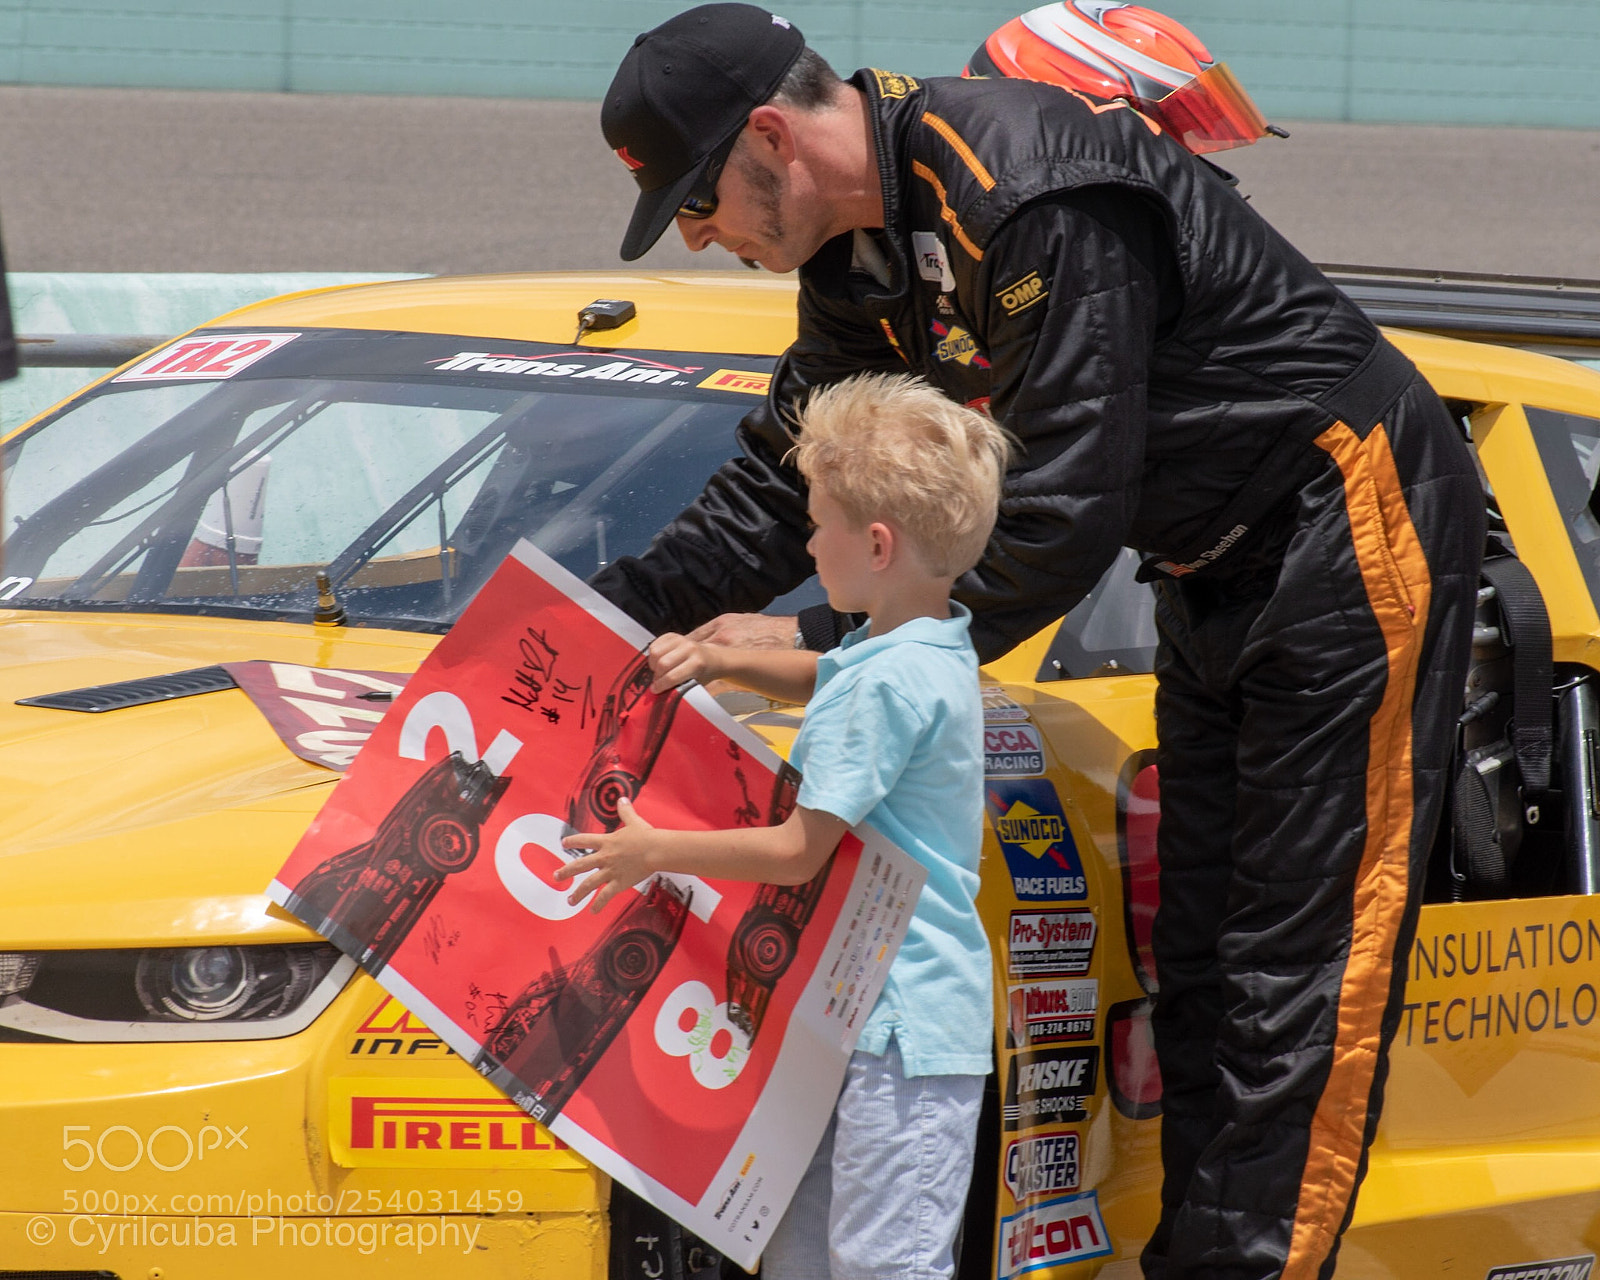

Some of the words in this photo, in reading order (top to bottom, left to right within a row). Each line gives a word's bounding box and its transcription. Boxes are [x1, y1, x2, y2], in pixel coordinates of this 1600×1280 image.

[1001, 277, 1043, 310] OMP
[142, 340, 273, 375] TA2
[938, 335, 975, 359] SUNOC
[434, 352, 586, 377] Trans
[571, 362, 680, 385] Am
[715, 374, 770, 391] PIR
[1200, 524, 1249, 561] Sheehan
[984, 730, 1038, 752] CCA
[984, 755, 1041, 771] RACING
[1000, 817, 1061, 841] SUNOCO
[1013, 876, 1046, 896] RACE
[1046, 875, 1086, 895] FUELS
[1011, 917, 1093, 949] Pro-System
[1407, 919, 1600, 982] NSULATION
[1016, 1059, 1089, 1095] PENSKE
[1040, 1095, 1077, 1114] SHOCKS
